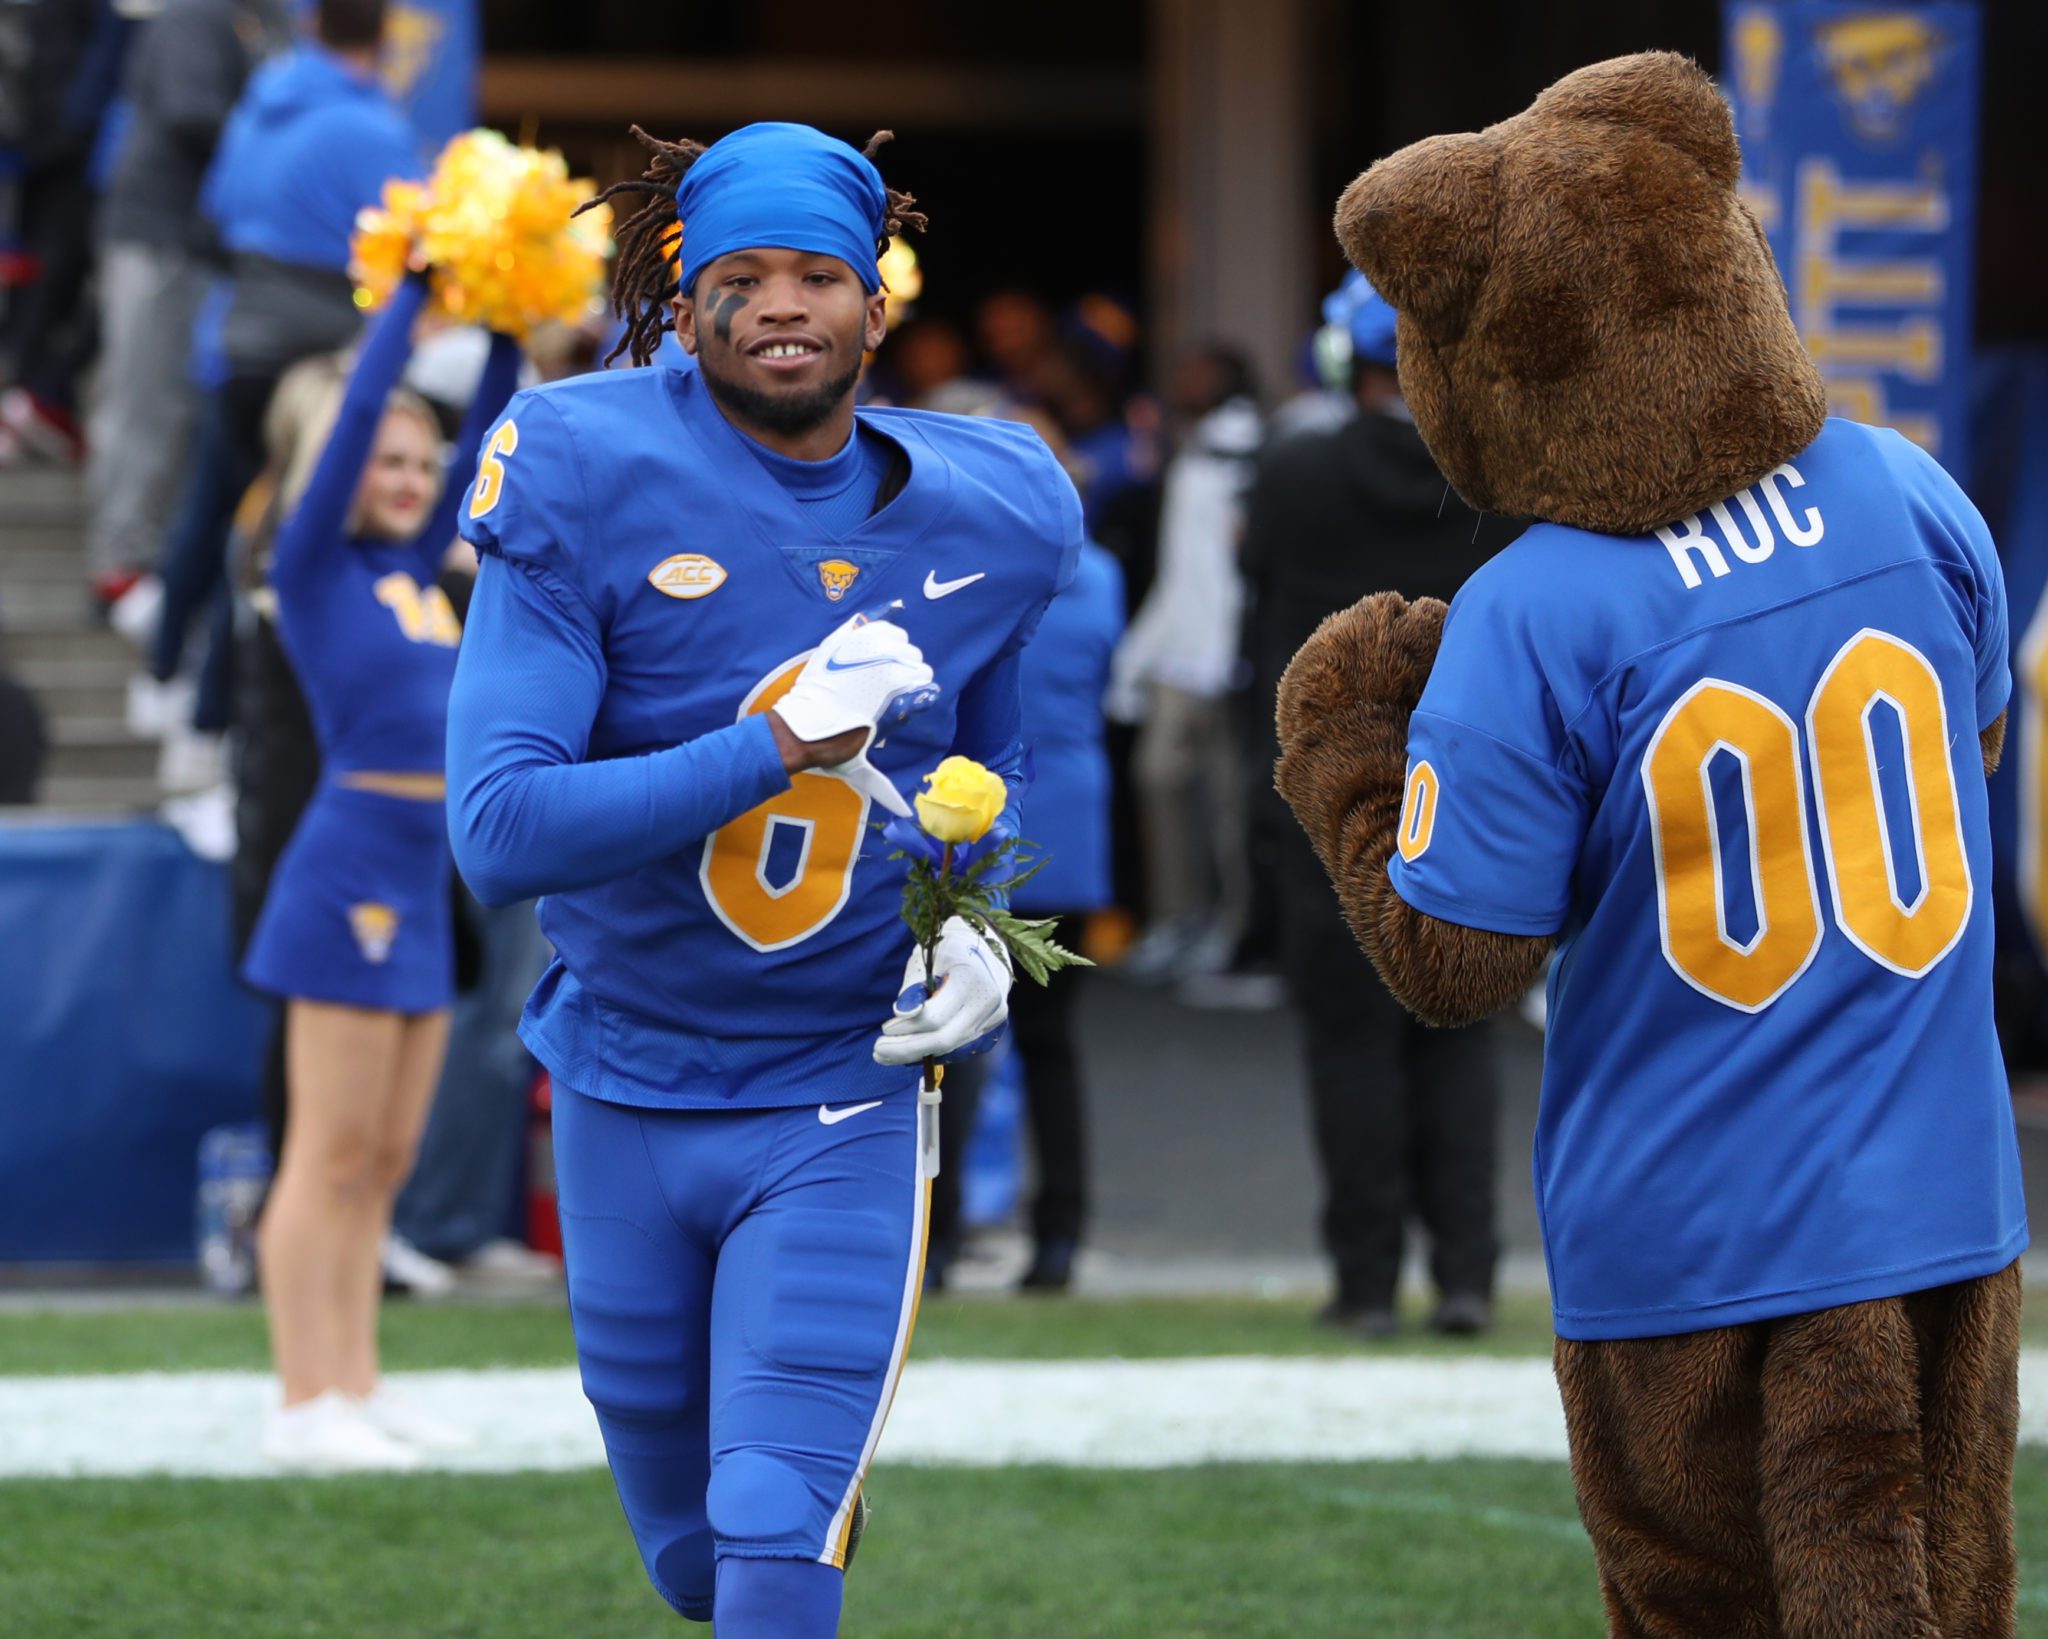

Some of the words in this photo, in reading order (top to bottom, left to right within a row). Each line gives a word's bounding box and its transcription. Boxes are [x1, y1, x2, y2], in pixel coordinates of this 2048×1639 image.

[469, 418, 519, 520] 6
[655, 565, 714, 586] ACC
[698, 646, 872, 954] 6
[1640, 627, 1974, 1015] 00
